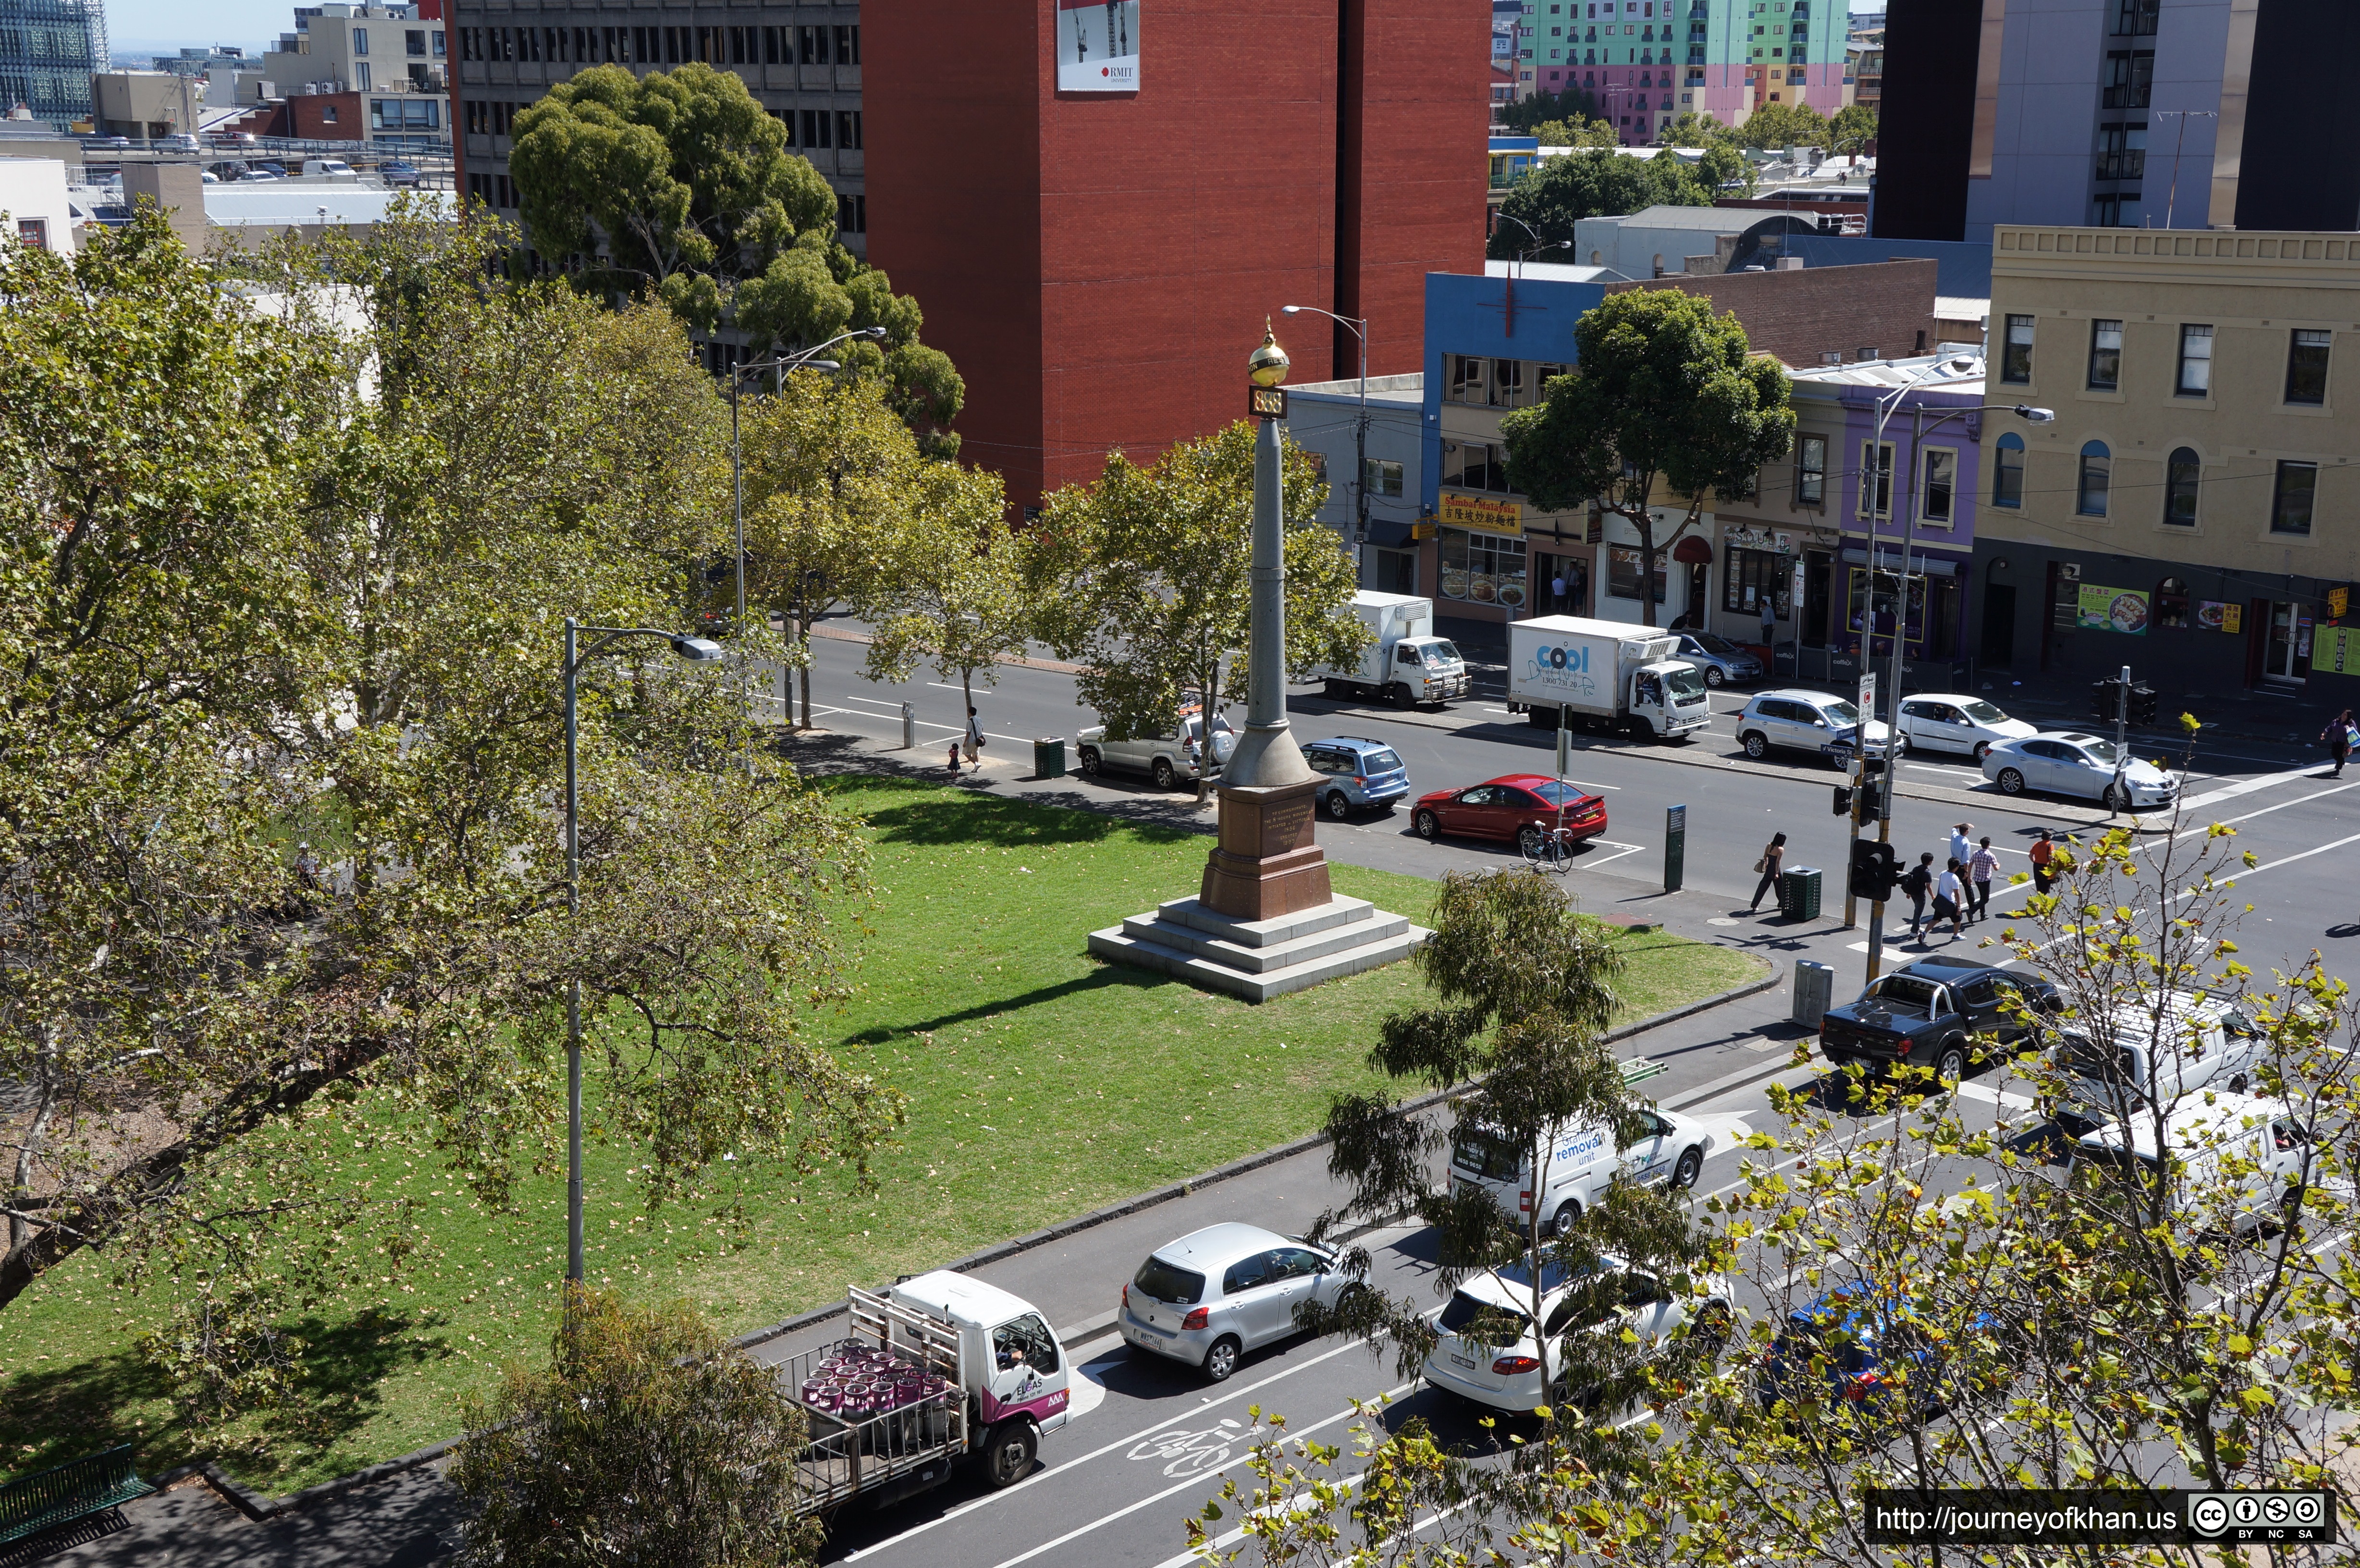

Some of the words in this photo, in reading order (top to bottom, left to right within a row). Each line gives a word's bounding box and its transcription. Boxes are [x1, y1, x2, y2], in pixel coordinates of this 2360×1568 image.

[1110, 67, 1133, 77] RMIT
[1267, 357, 1286, 365] REST
[1445, 496, 1475, 509] Sambal
[1478, 501, 1516, 514] Malaysia
[1736, 531, 1774, 545] SOUL
[1292, 816, 1311, 824] VICTORIA
[1556, 1133, 1602, 1162] removal
[1457, 1157, 1468, 1165] 9658
[1469, 1161, 1482, 1170] 9658
[1578, 1151, 1595, 1165] unit
[1152, 1337, 1160, 1346] 166
[1017, 1378, 1043, 1396] ELGAS
